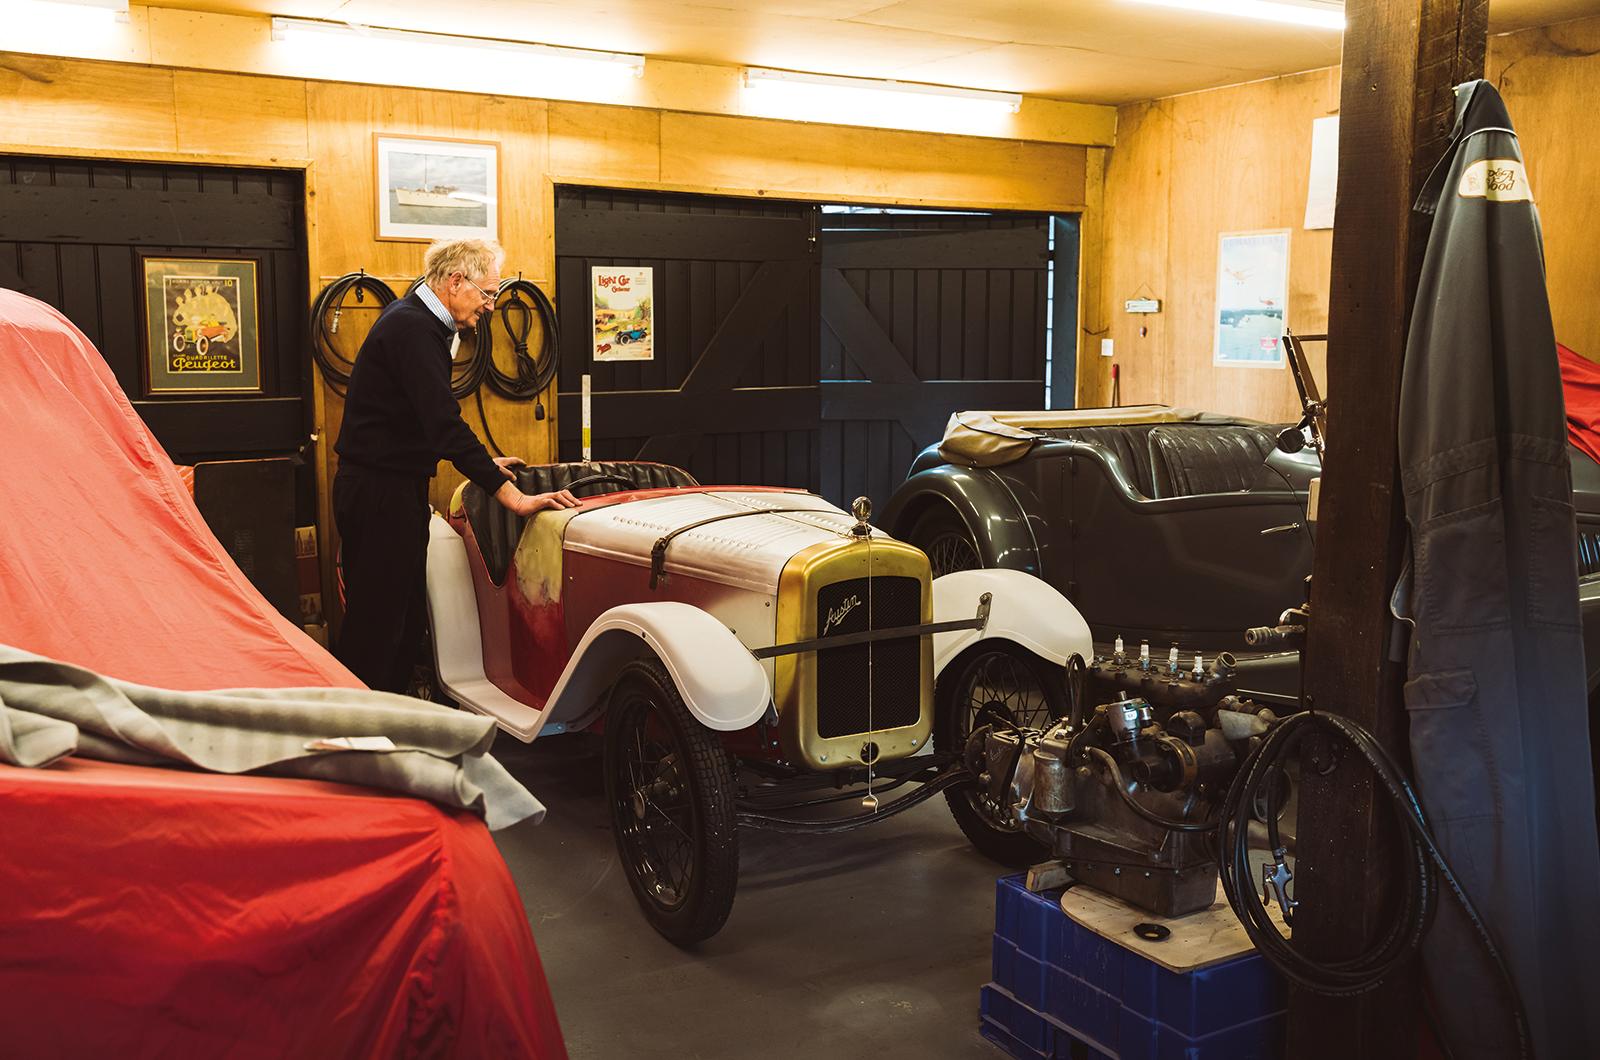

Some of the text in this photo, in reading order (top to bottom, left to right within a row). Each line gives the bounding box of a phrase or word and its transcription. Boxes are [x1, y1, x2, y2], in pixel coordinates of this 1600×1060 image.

[1223, 235, 1287, 247] DE HAVILLAND
[224, 279, 233, 287] 10
[598, 275, 617, 288] Light
[173, 357, 236, 371] Peugeot
[823, 594, 862, 636] Austin
